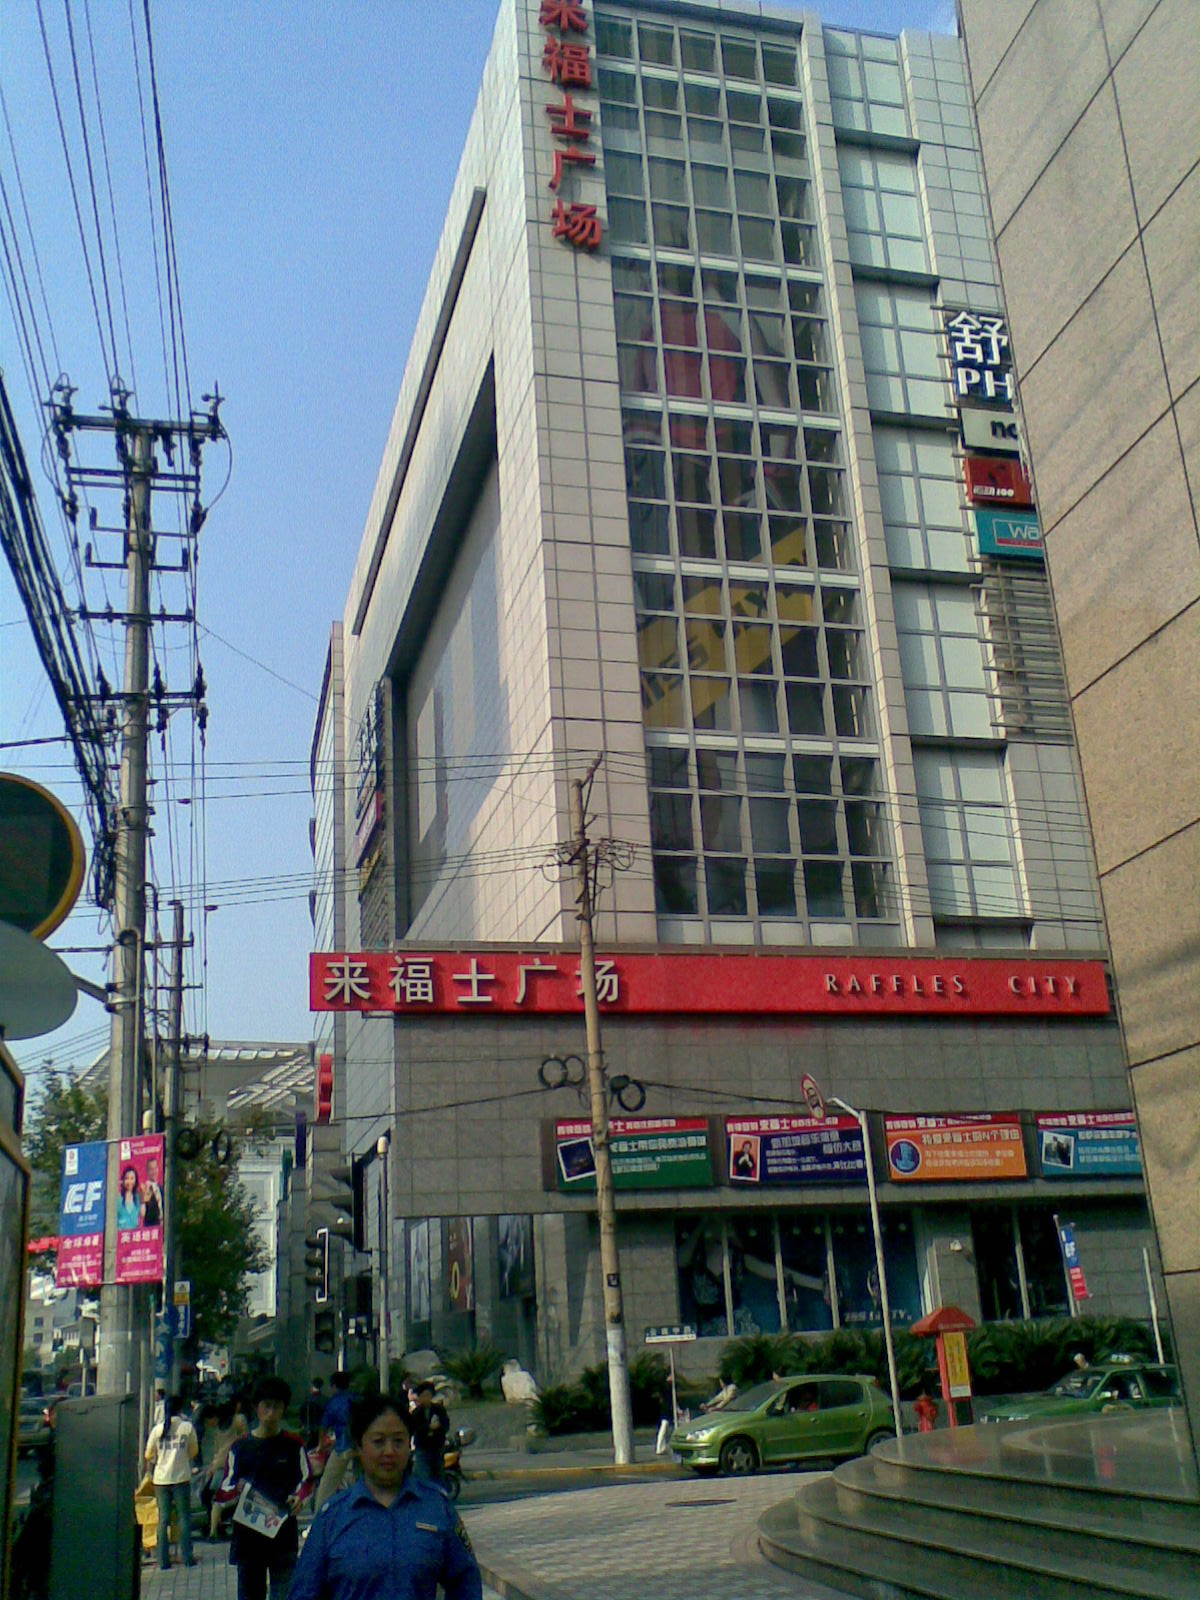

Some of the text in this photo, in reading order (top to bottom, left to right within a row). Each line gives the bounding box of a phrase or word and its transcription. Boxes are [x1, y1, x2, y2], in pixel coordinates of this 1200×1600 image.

[949, 311, 1008, 365] 舒
[957, 368, 1013, 400] PH
[323, 956, 619, 1004] 来福士广场
[825, 974, 1078, 994] RAFFLES CITY
[64, 1181, 103, 1214] EF
